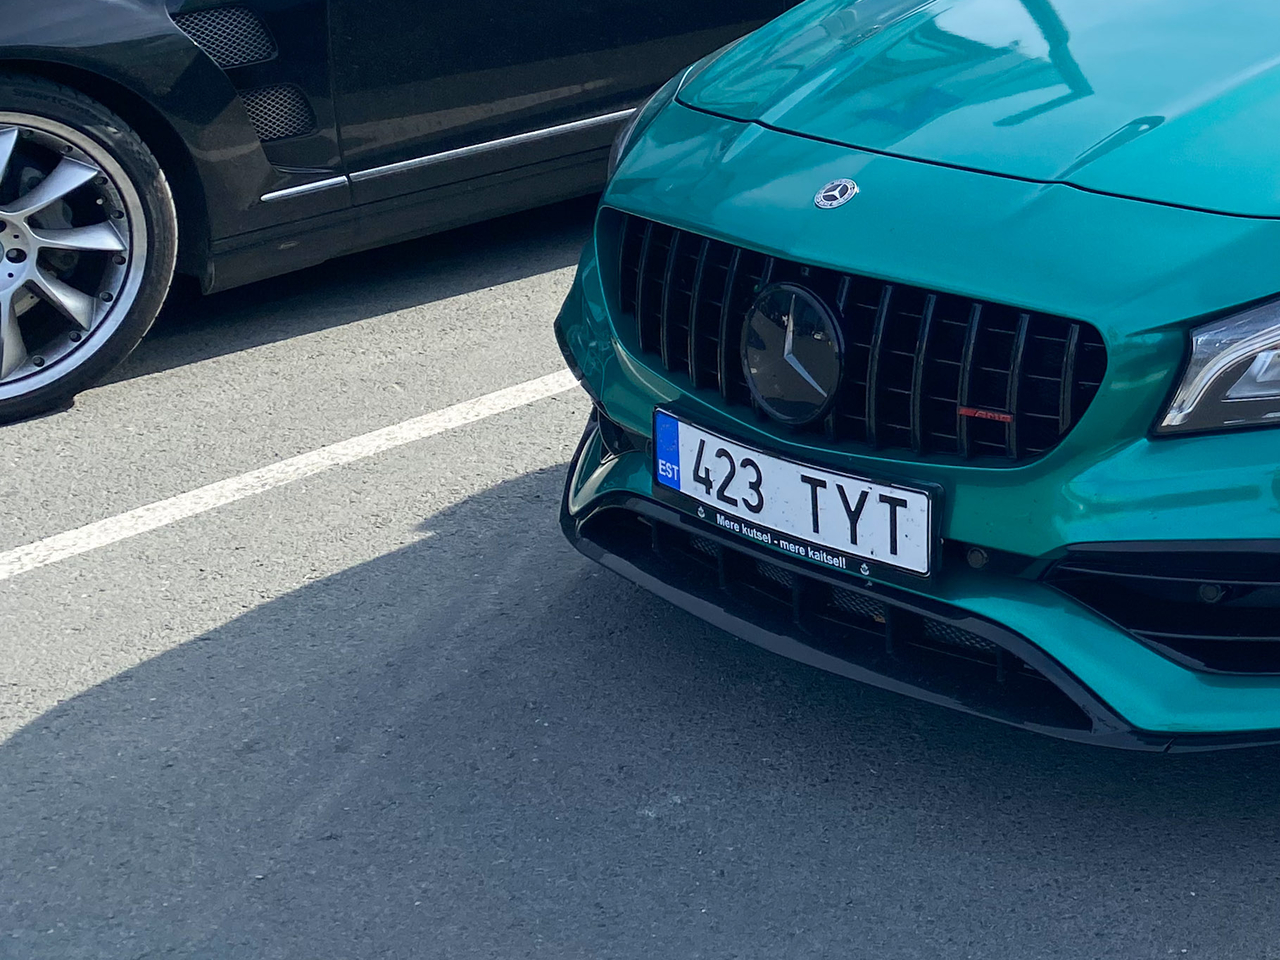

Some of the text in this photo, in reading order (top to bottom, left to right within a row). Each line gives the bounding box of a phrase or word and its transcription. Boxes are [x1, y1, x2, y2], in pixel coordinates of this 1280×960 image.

[658, 458, 680, 482] EST
[692, 438, 908, 556] 423 TYT
[716, 513, 740, 532] Mere
[741, 523, 771, 545] kutsel
[779, 540, 806, 556] mere
[807, 546, 847, 569] kaitsel!
